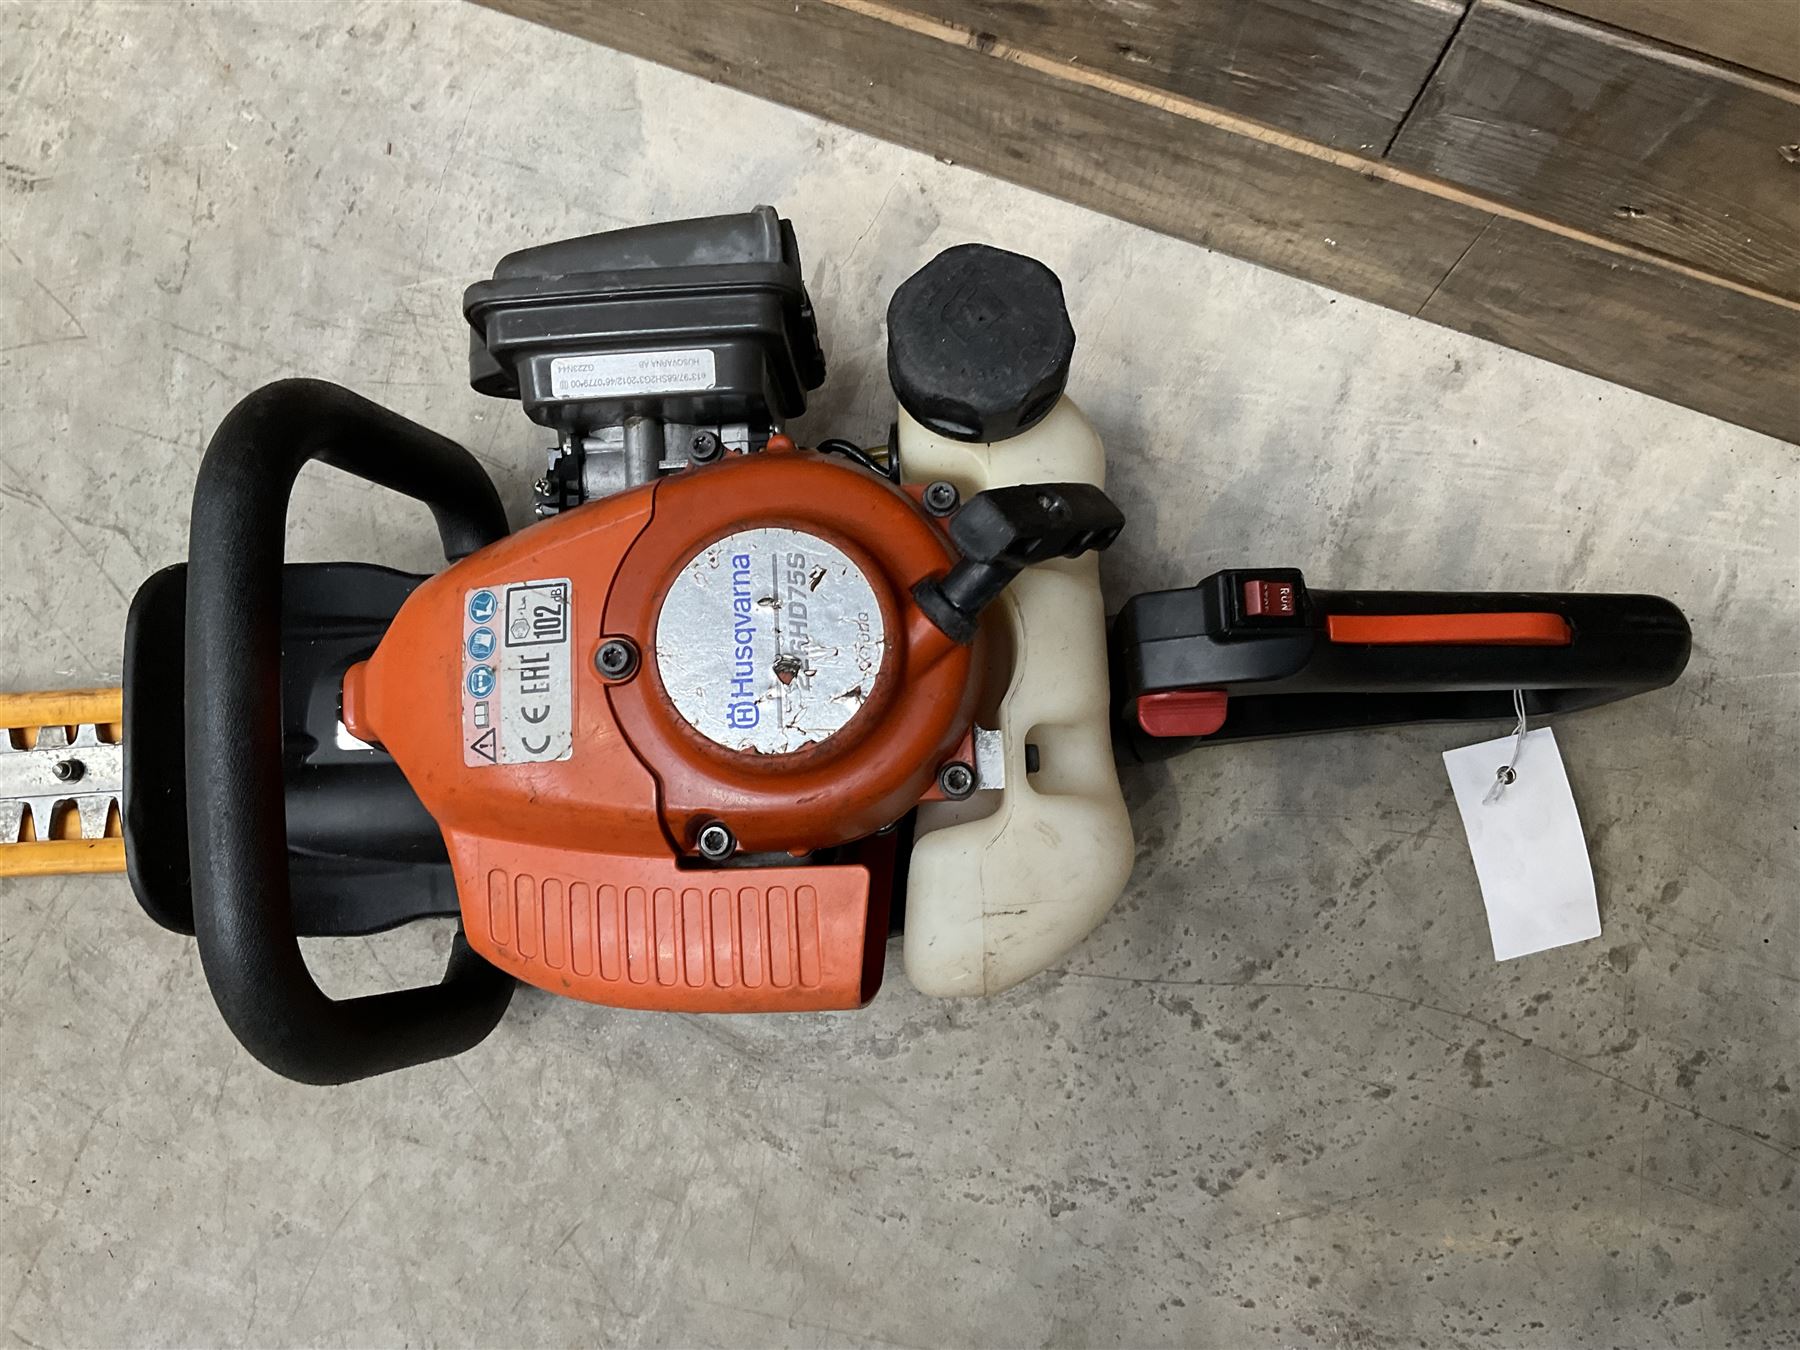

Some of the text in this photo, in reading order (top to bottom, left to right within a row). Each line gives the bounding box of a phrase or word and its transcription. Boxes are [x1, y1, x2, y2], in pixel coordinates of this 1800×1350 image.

[638, 357, 700, 369] HUSQVARNA AB
[533, 588, 562, 639] 102 dB
[1280, 587, 1291, 612] RUN
[730, 553, 757, 698] Husqvarna
[521, 704, 551, 754] CE
